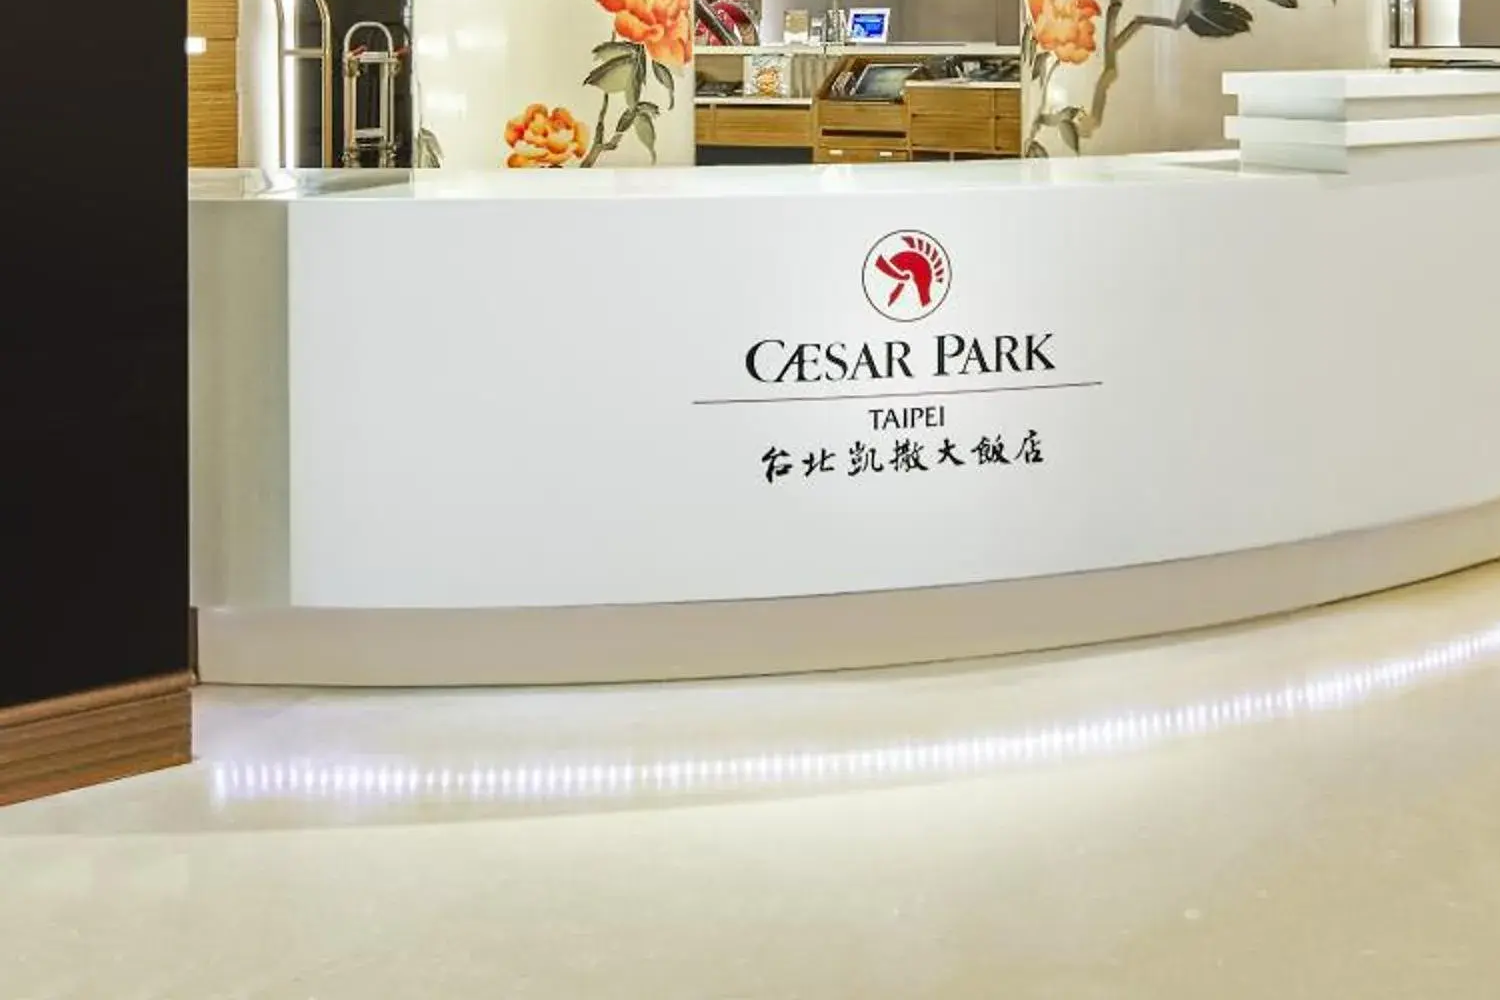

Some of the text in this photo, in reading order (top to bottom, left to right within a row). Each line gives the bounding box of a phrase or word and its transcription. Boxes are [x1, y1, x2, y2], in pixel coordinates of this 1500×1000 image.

[934, 332, 1056, 377] PARK
[868, 405, 946, 431] TAIPEI
[760, 428, 1045, 484] 台北凱撒大飯店
